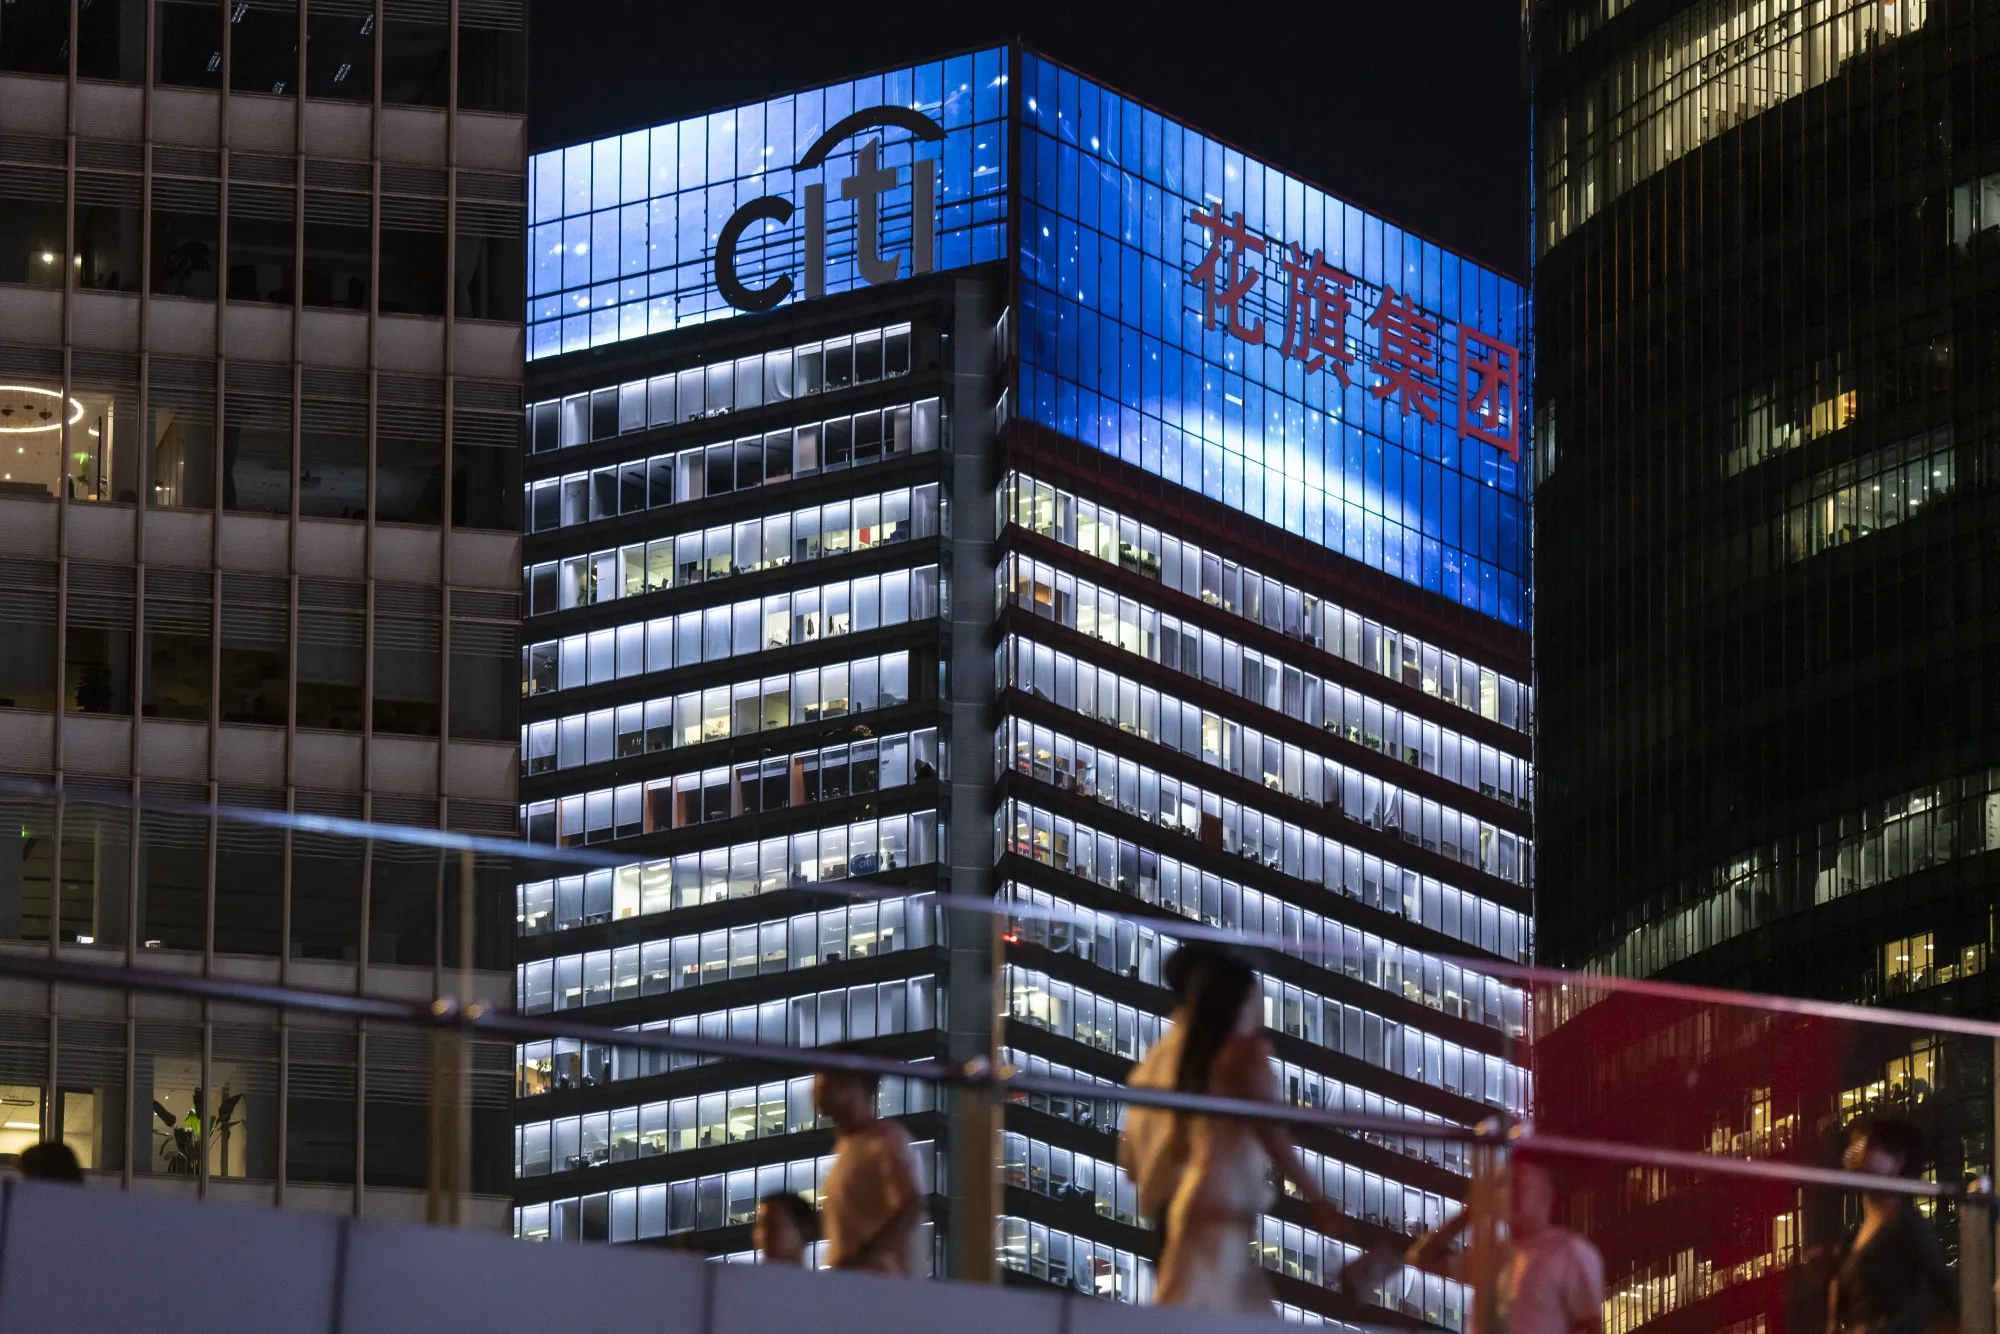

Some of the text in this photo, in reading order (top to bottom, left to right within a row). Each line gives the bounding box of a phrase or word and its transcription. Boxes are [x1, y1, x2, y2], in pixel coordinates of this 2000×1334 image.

[714, 105, 948, 312] citi
[1190, 202, 1520, 463] 花旗集团
